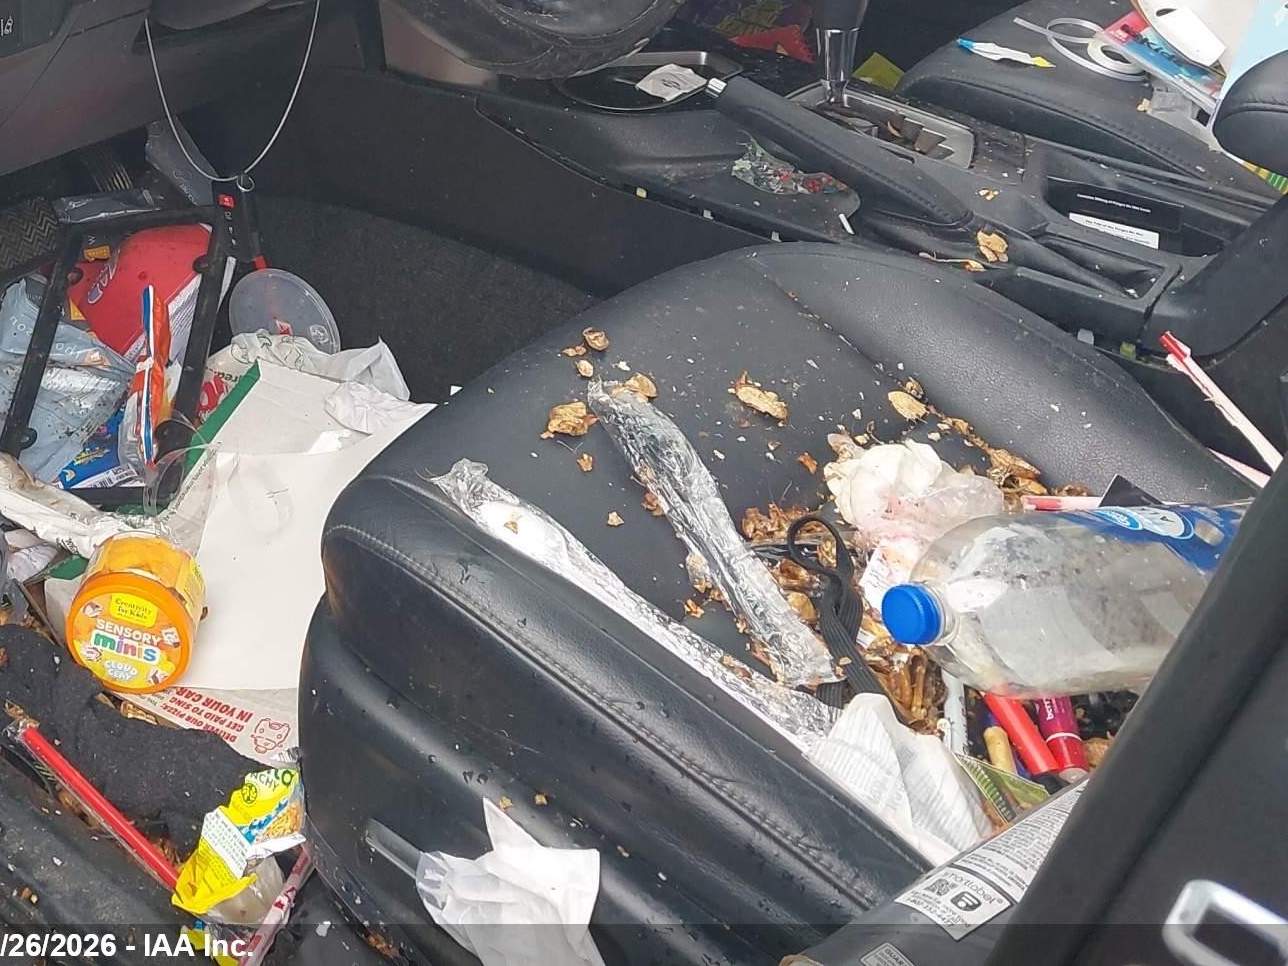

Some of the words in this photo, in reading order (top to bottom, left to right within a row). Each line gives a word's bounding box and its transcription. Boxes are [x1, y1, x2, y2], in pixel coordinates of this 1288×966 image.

[115, 597, 152, 616] Creativity
[96, 618, 162, 646] SENSORY
[93, 632, 157, 662] minis
[103, 659, 138, 677] CLOUD
[169, 696, 191, 710] SING
[202, 697, 237, 718] YOUR
[191, 706, 204, 717] TO
[203, 712, 228, 726] PAID
[237, 709, 254, 723] IN
[184, 714, 204, 727] OUR
[228, 721, 245, 733] GET
[203, 722, 238, 744] DELIVER
